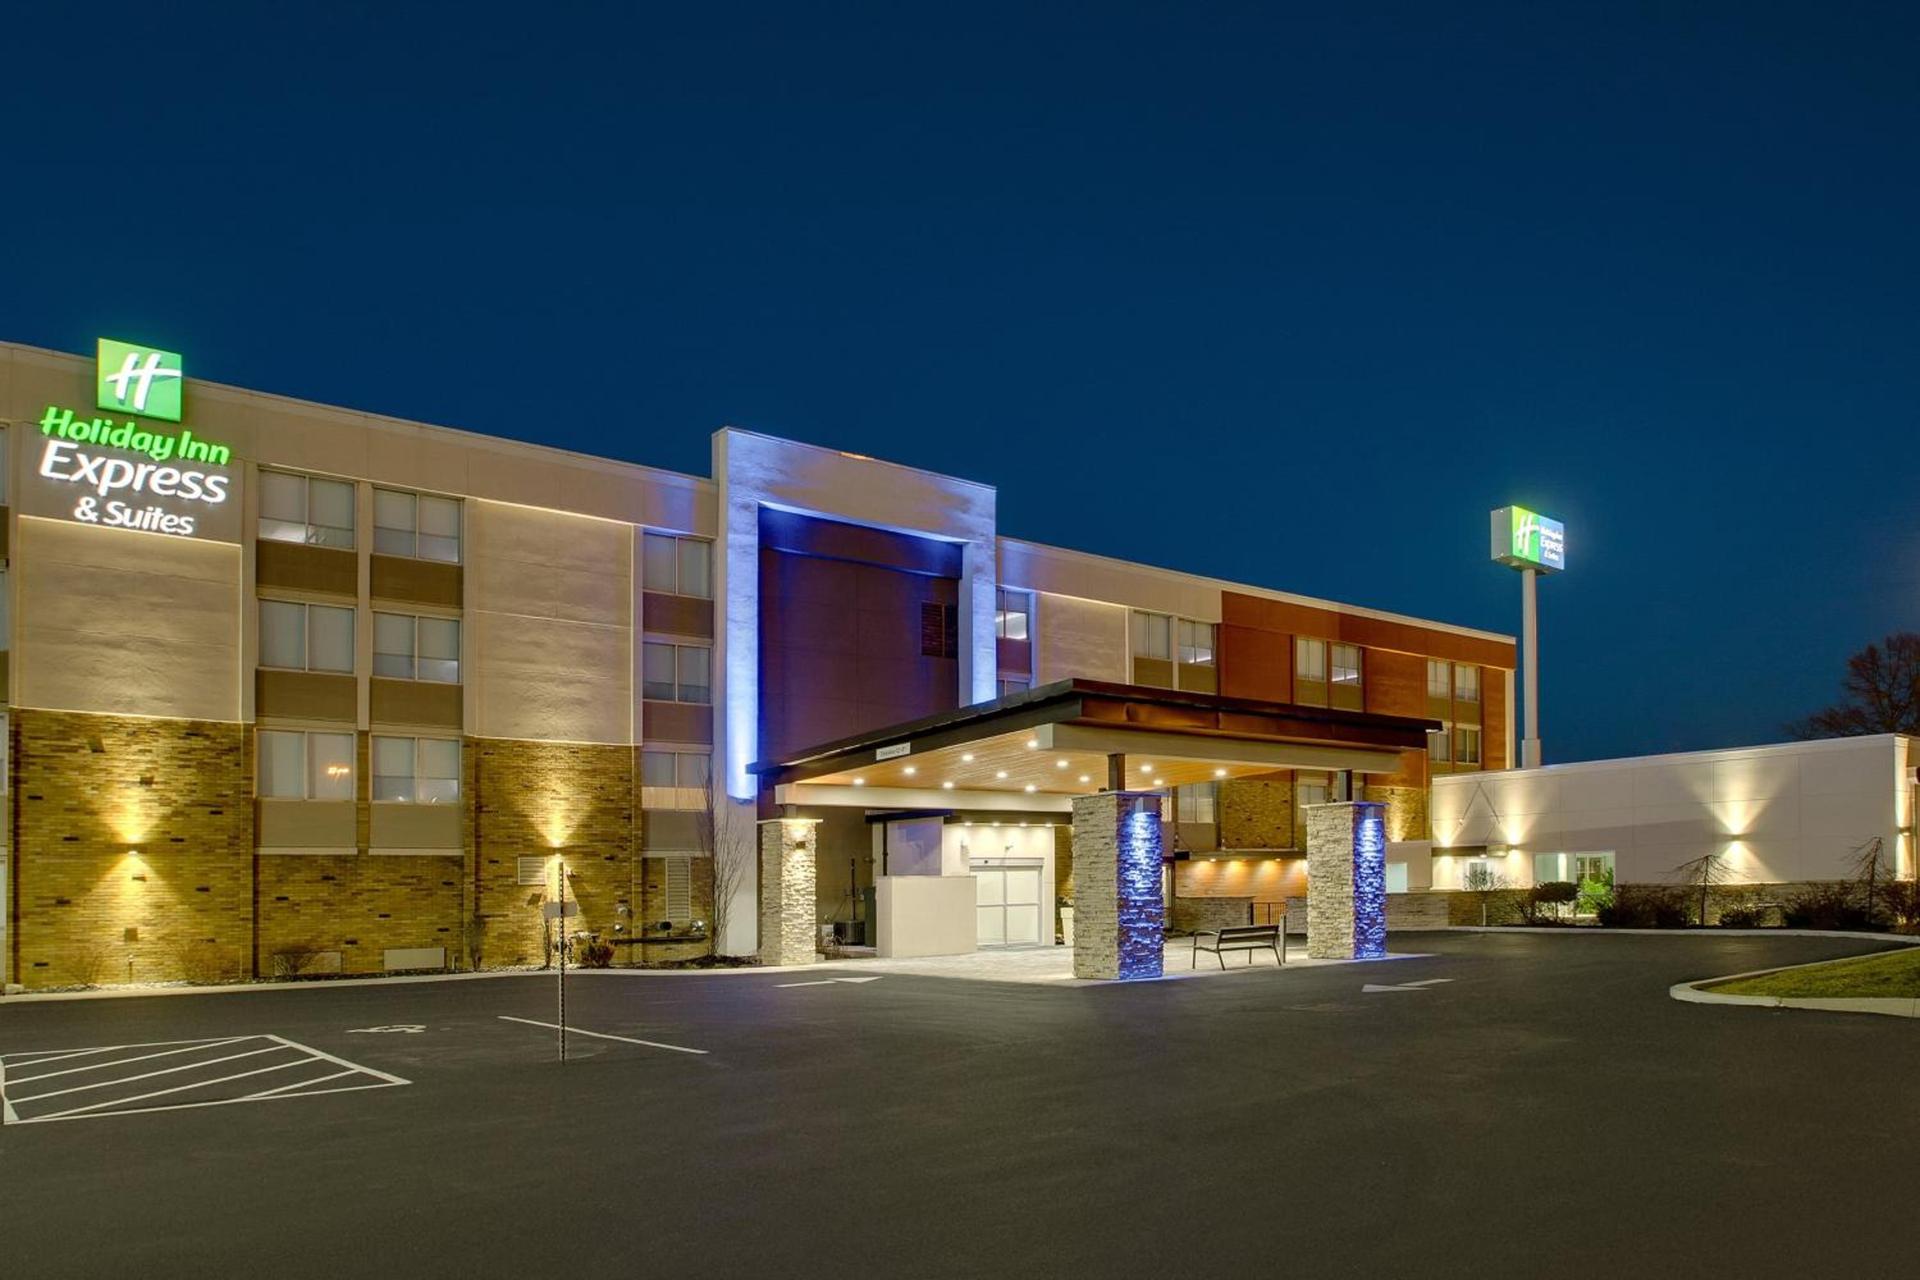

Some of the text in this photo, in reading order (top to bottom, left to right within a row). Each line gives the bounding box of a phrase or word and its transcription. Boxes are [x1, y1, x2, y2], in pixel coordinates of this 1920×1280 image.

[105, 352, 182, 411] H
[40, 406, 229, 465] Holiday Inn
[39, 439, 229, 503] Express
[74, 496, 194, 534] & Suites
